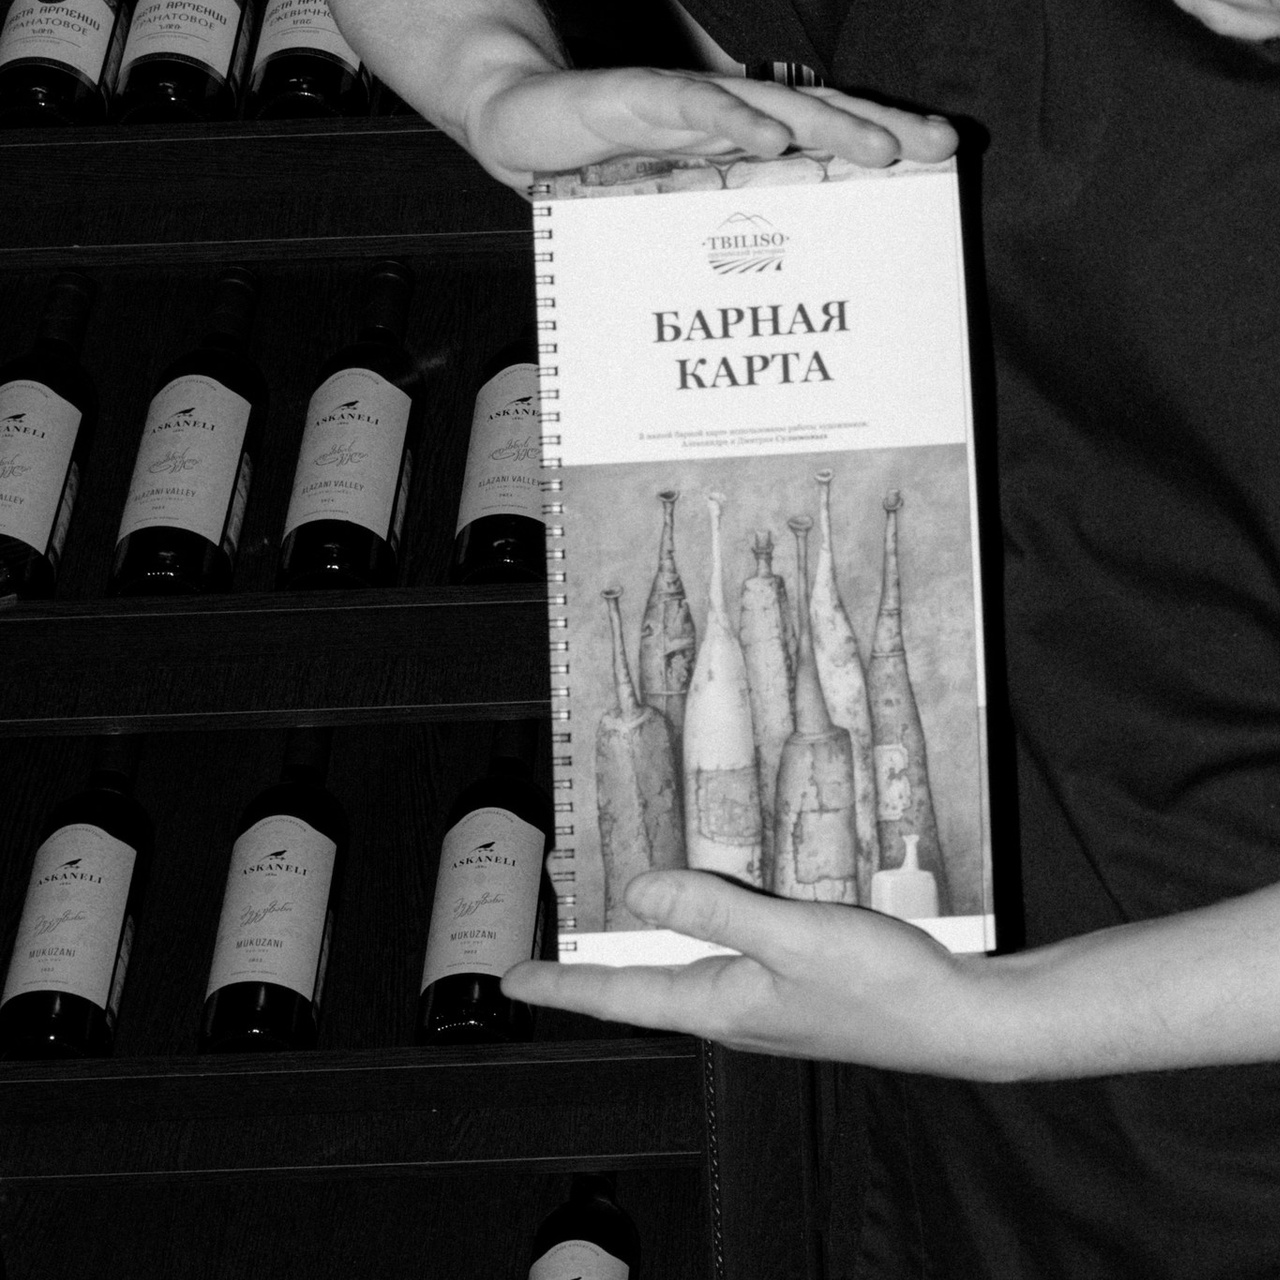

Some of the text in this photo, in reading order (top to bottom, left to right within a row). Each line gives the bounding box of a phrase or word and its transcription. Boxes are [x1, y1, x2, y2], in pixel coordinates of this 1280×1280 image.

[40, 5, 100, 31] АРМЕНИИ
[166, 1, 227, 26] АРМЕНИИ
[707, 232, 785, 251] TBILISO
[652, 300, 850, 344] БАРНАЯ
[675, 350, 834, 391] КАРТА
[316, 413, 379, 427] ASKANELI
[488, 408, 539, 422] ASKANE
[3, 425, 45, 439] ANELI
[151, 420, 215, 435] ASKANELI
[165, 487, 196, 498] VALLEY
[334, 480, 364, 492] VALLEY
[0, 493, 24, 505] ALLEY
[243, 863, 307, 876] ASKANELI
[452, 855, 516, 870] ASKANELI
[38, 872, 102, 886] ASKANELI
[450, 930, 497, 941] MUKUZANI
[236, 938, 283, 949] MUKUZANI
[28, 947, 76, 959] MUKUZANI
